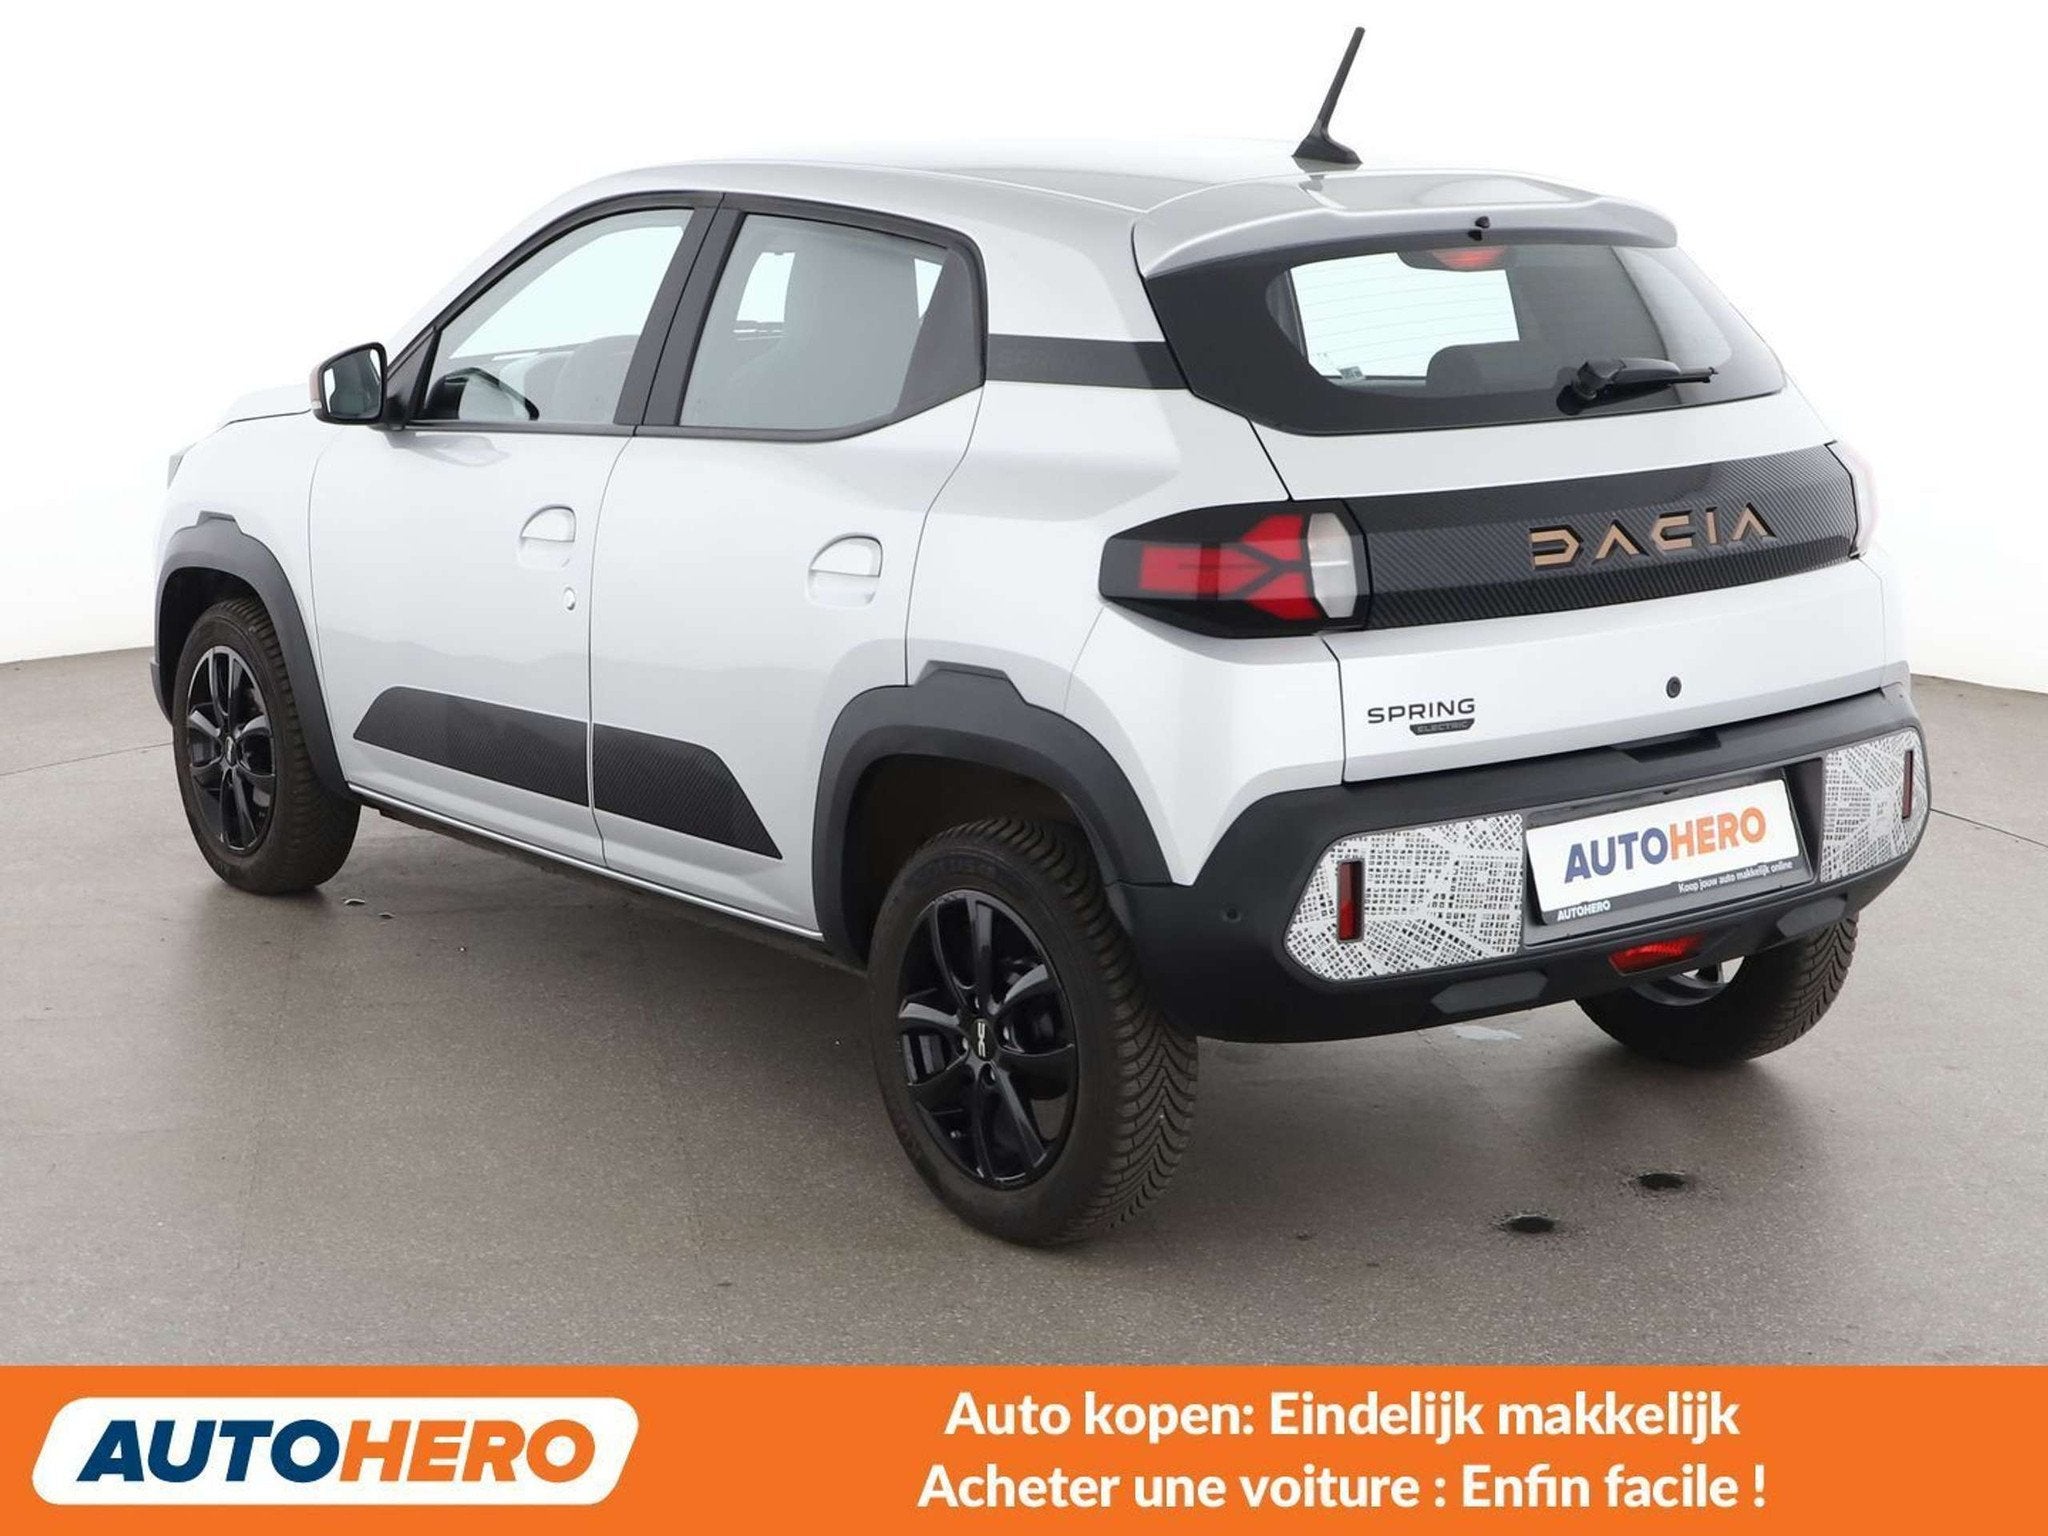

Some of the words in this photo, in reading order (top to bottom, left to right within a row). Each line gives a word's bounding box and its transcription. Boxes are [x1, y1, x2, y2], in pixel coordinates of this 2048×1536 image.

[1529, 503, 1775, 569] DACIA
[1367, 698, 1475, 724] SPRING
[1417, 720, 1470, 733] ELECTRIC
[1564, 806, 1766, 884] AUTOHERO
[1678, 882, 1699, 893] Koop
[1699, 878, 1718, 890] jouw
[1718, 874, 1736, 884] auto
[1736, 864, 1770, 880] makkelijk
[1770, 860, 1793, 873] online
[1557, 899, 1611, 922] AUTOHERO
